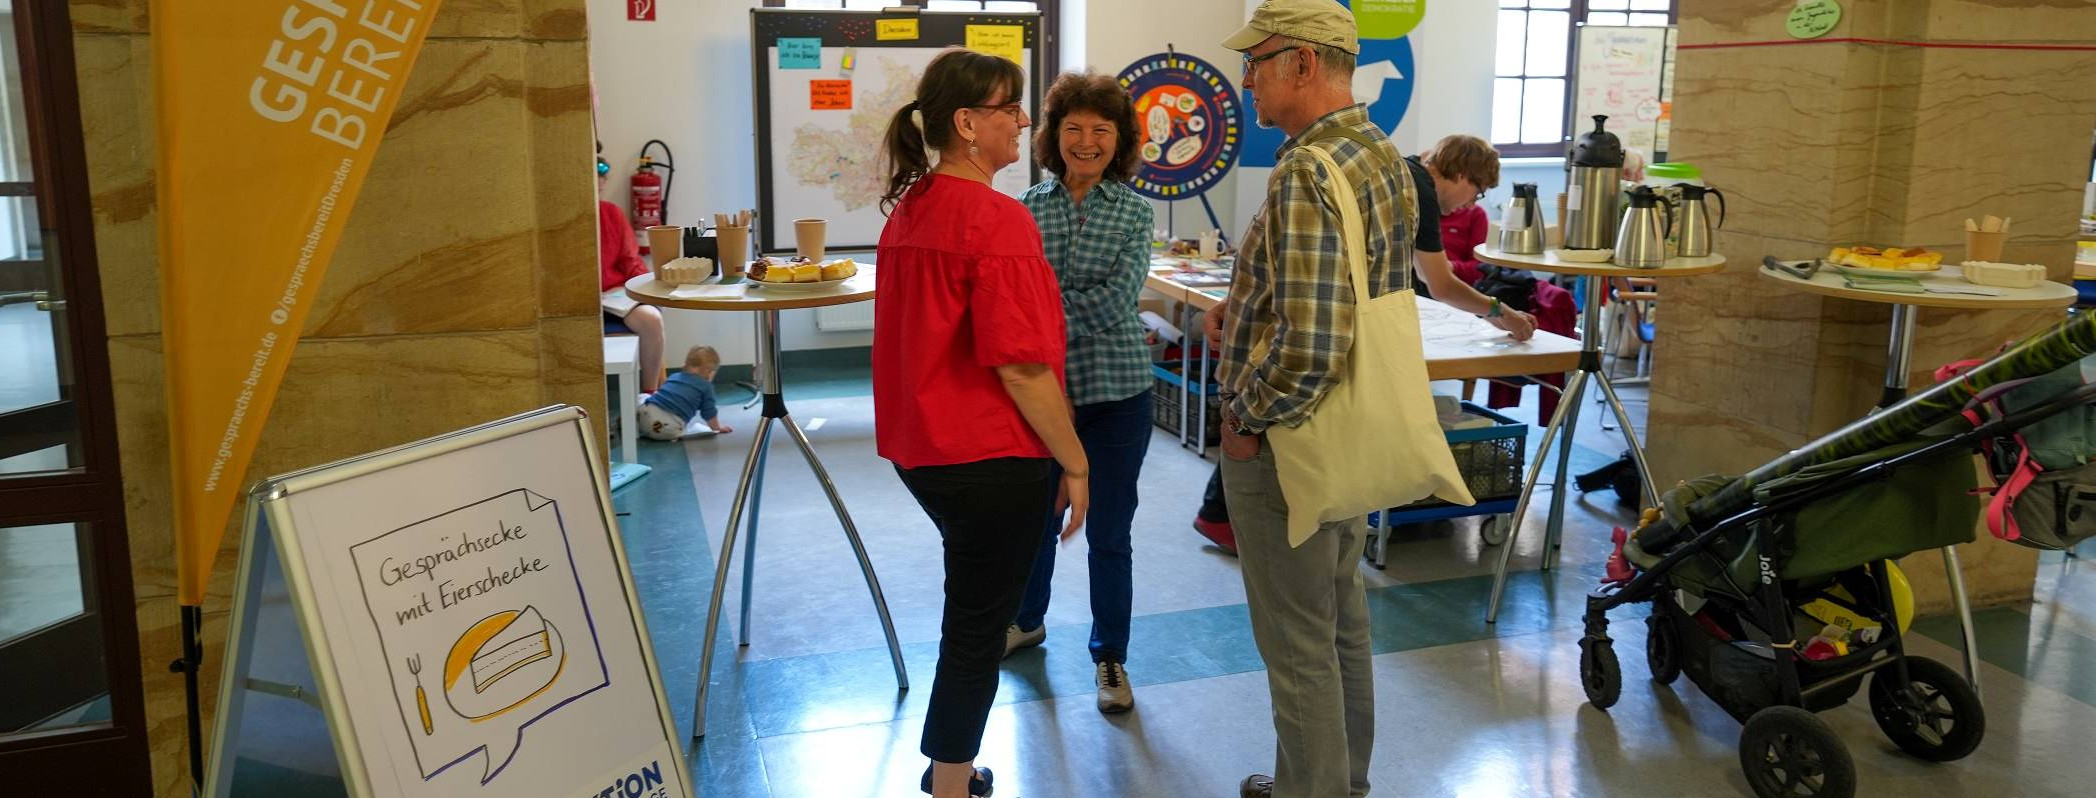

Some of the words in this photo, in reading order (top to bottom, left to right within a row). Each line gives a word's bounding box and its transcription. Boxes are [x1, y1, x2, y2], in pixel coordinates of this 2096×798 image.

[204, 331, 278, 493] www.gespraechs-bereit.de
[379, 519, 528, 587] Gesprächsecke
[1759, 554, 1776, 585] Joie
[395, 592, 434, 626] mit
[438, 556, 550, 610] Eierschecke
